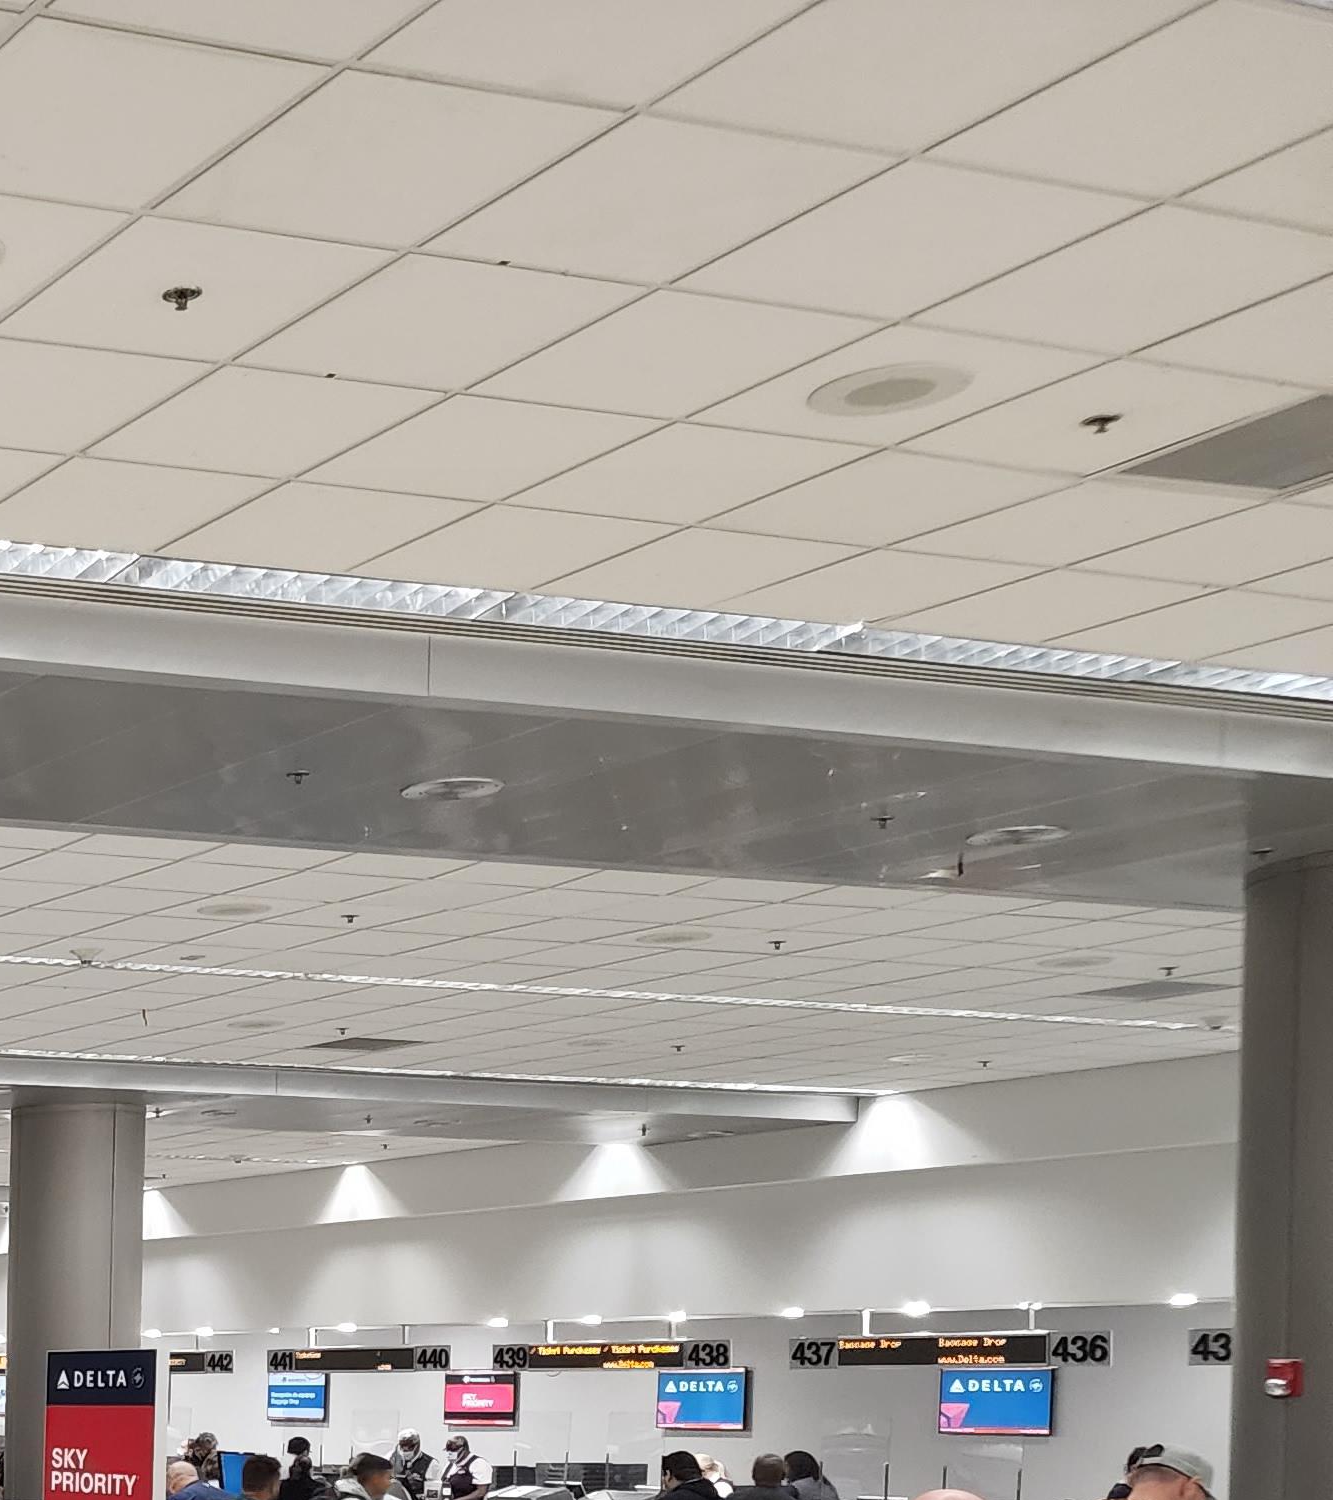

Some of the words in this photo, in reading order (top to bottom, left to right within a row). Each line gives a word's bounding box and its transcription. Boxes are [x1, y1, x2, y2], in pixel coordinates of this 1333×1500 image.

[417, 1348, 450, 1369] 440
[494, 1347, 528, 1369] 439
[688, 1343, 729, 1366] 438
[791, 1341, 835, 1366] 437
[1052, 1335, 1109, 1363] 436
[1191, 1333, 1232, 1362] 43
[207, 1353, 233, 1371] 442
[269, 1351, 293, 1370] 441
[74, 1370, 127, 1388] DELTA
[679, 1381, 725, 1392] DELTA
[968, 1379, 1025, 1392] DELTA
[51, 1447, 88, 1469] SKY
[51, 1471, 137, 1496] PRIORITY
